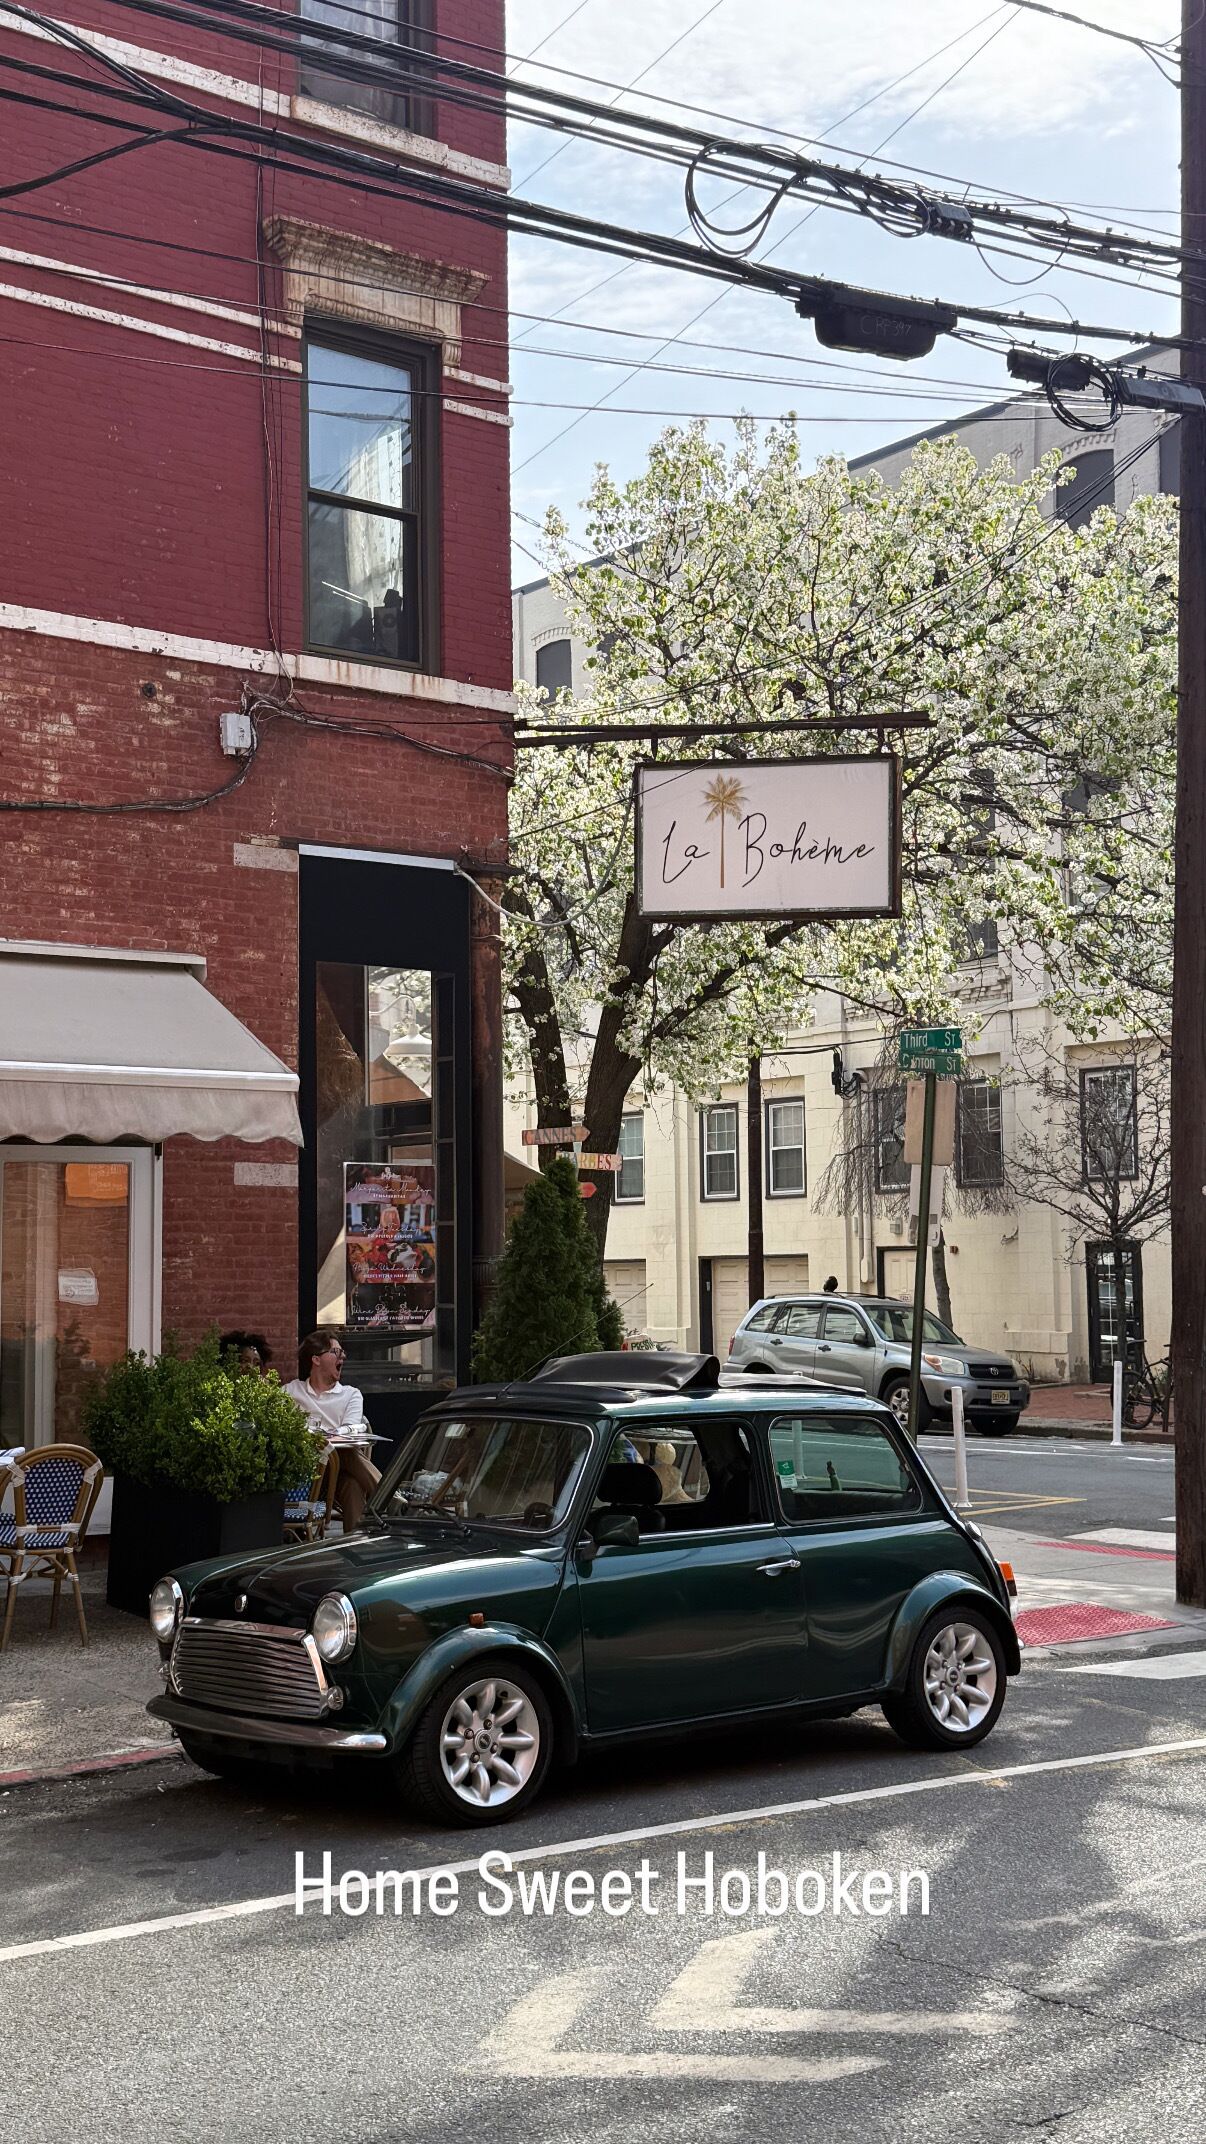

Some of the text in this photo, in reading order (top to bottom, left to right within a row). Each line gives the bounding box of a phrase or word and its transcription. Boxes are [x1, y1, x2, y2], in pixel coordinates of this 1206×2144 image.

[662, 812, 875, 888] La Bohème
[904, 1032, 928, 1049] Third
[524, 1127, 577, 1145] CANNES
